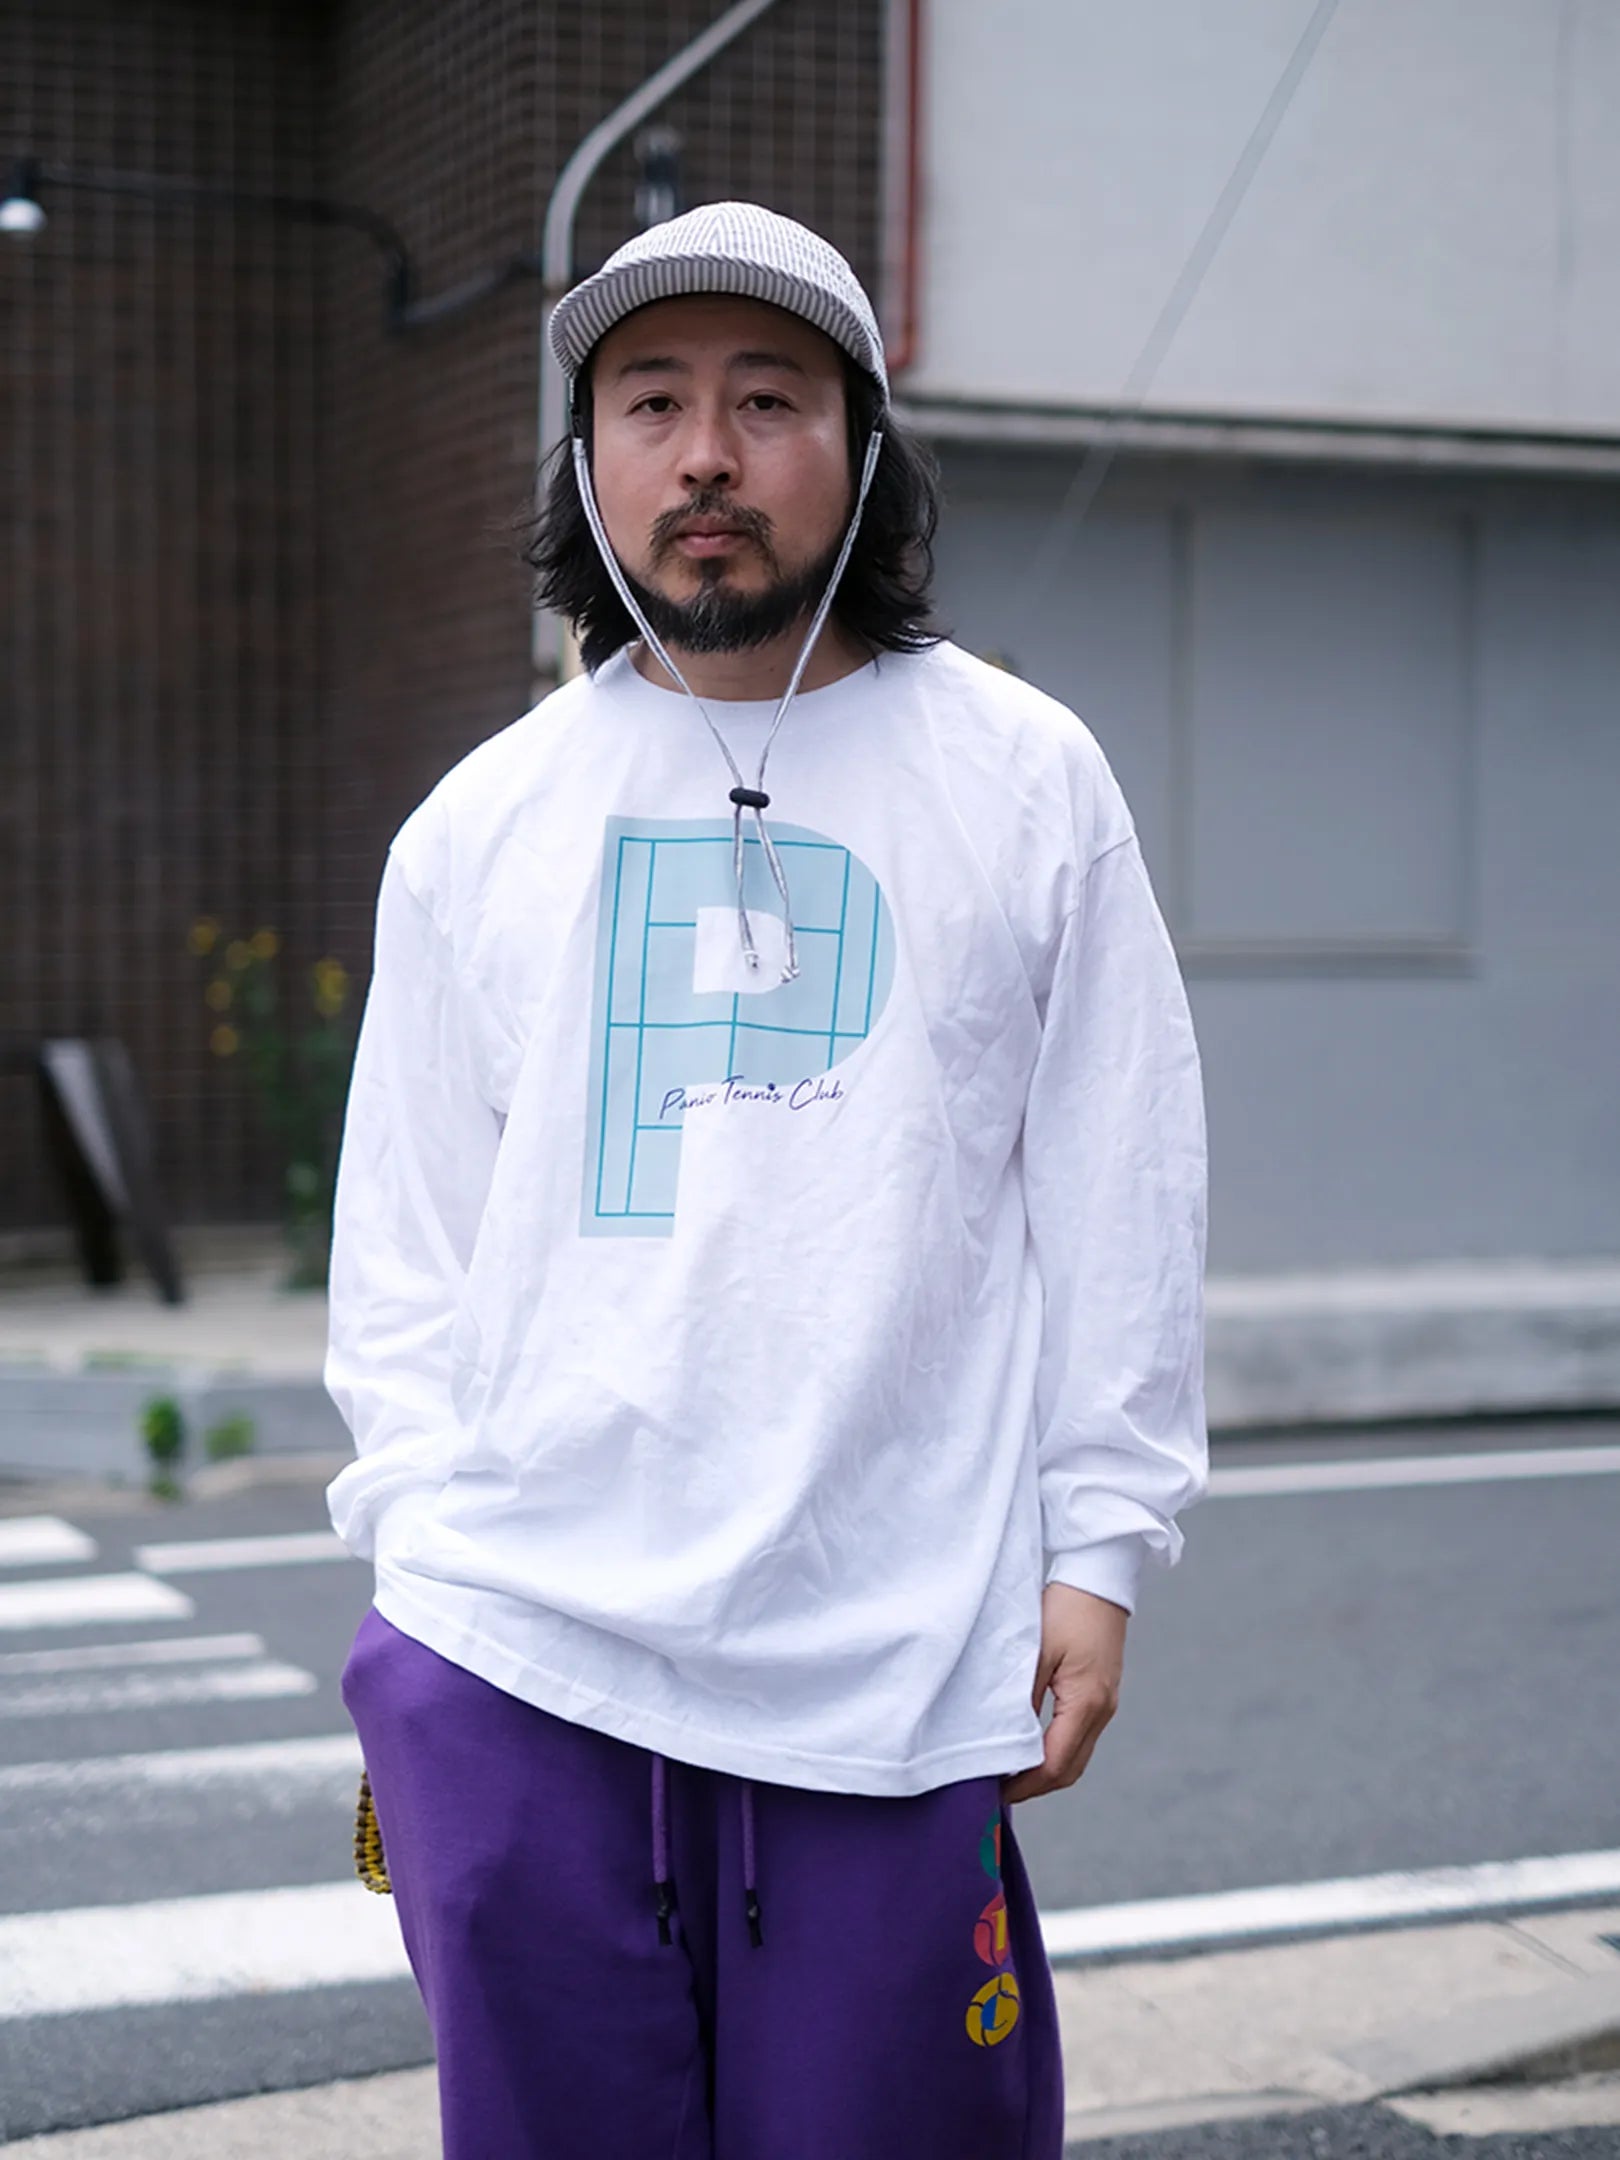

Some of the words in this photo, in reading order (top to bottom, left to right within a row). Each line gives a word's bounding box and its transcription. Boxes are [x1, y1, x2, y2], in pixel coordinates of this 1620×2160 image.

[579, 815, 897, 1239] P
[721, 1075, 783, 1105] Tennis
[788, 1077, 844, 1111] Club
